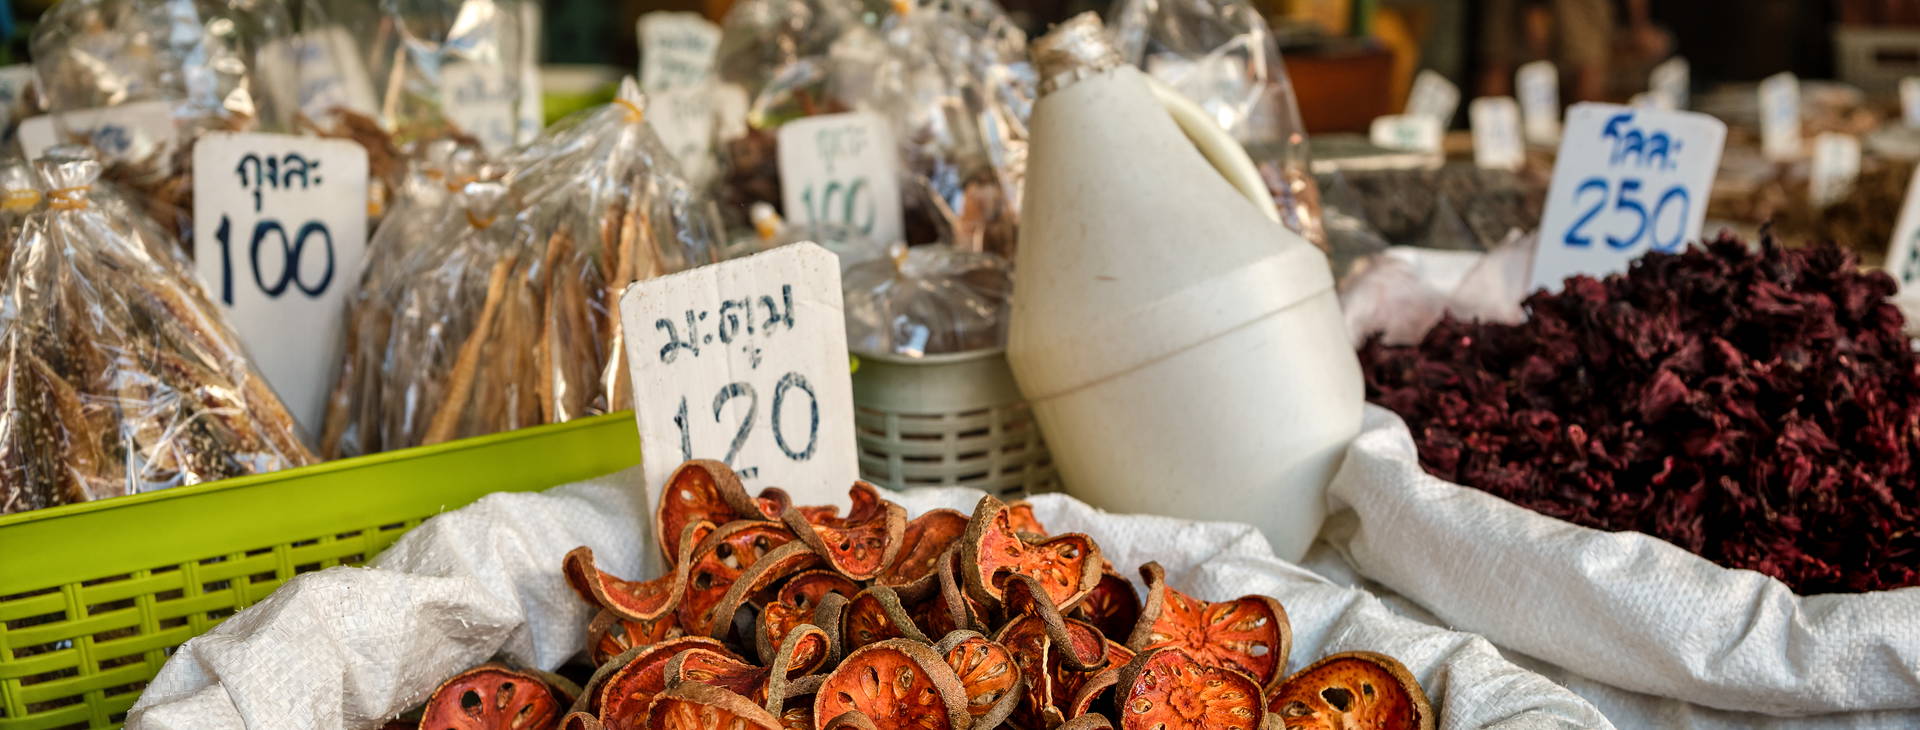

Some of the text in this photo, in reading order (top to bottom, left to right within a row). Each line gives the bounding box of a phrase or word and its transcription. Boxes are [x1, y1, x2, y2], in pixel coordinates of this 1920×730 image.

[214, 212, 336, 307] 100
[1563, 176, 1691, 255] 250
[655, 283, 795, 370] มะตูม
[672, 371, 820, 479] 120
